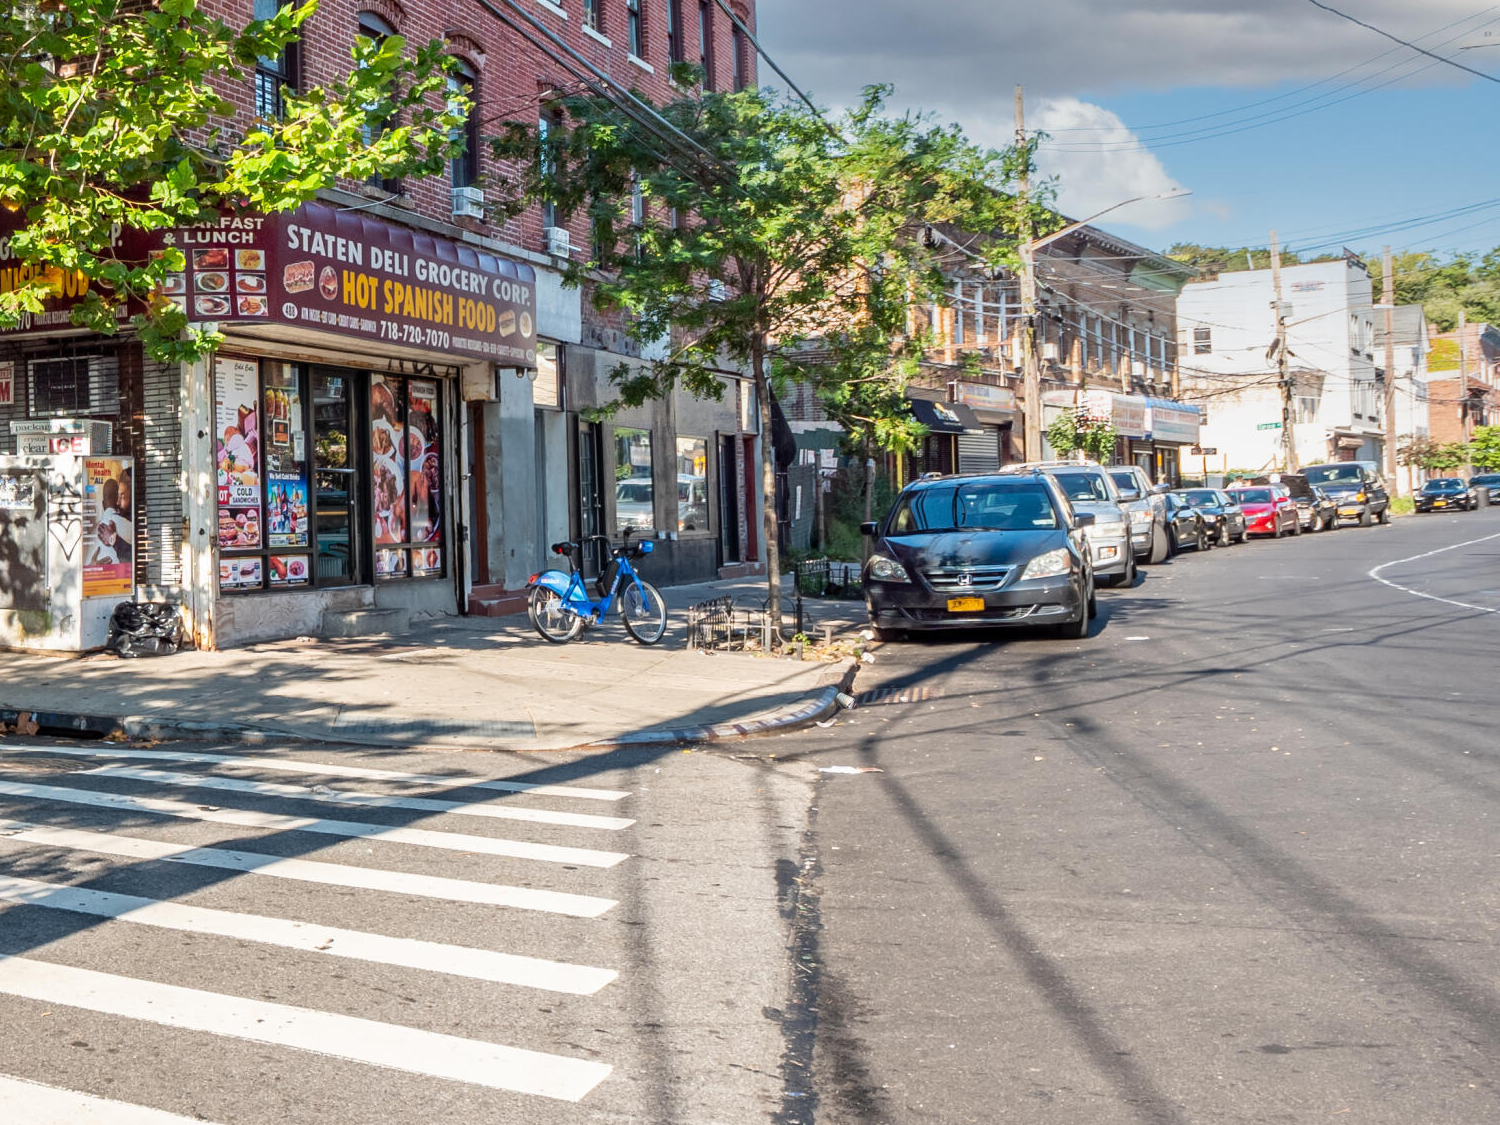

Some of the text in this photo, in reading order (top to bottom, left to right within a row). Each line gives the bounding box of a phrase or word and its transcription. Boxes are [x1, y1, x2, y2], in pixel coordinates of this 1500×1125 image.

[163, 231, 254, 244] & LUNCH
[287, 224, 531, 306] STATEN DELI GROCERY CORP.
[342, 270, 497, 343] HOT SPANISH FOOD
[380, 320, 450, 349] 718-720-7070
[22, 437, 83, 455] clear ICE
[24, 436, 46, 444] crystal
[85, 460, 105, 469] Mental
[93, 469, 112, 477] Health
[219, 490, 228, 502] OT
[236, 487, 253, 497] COLD
